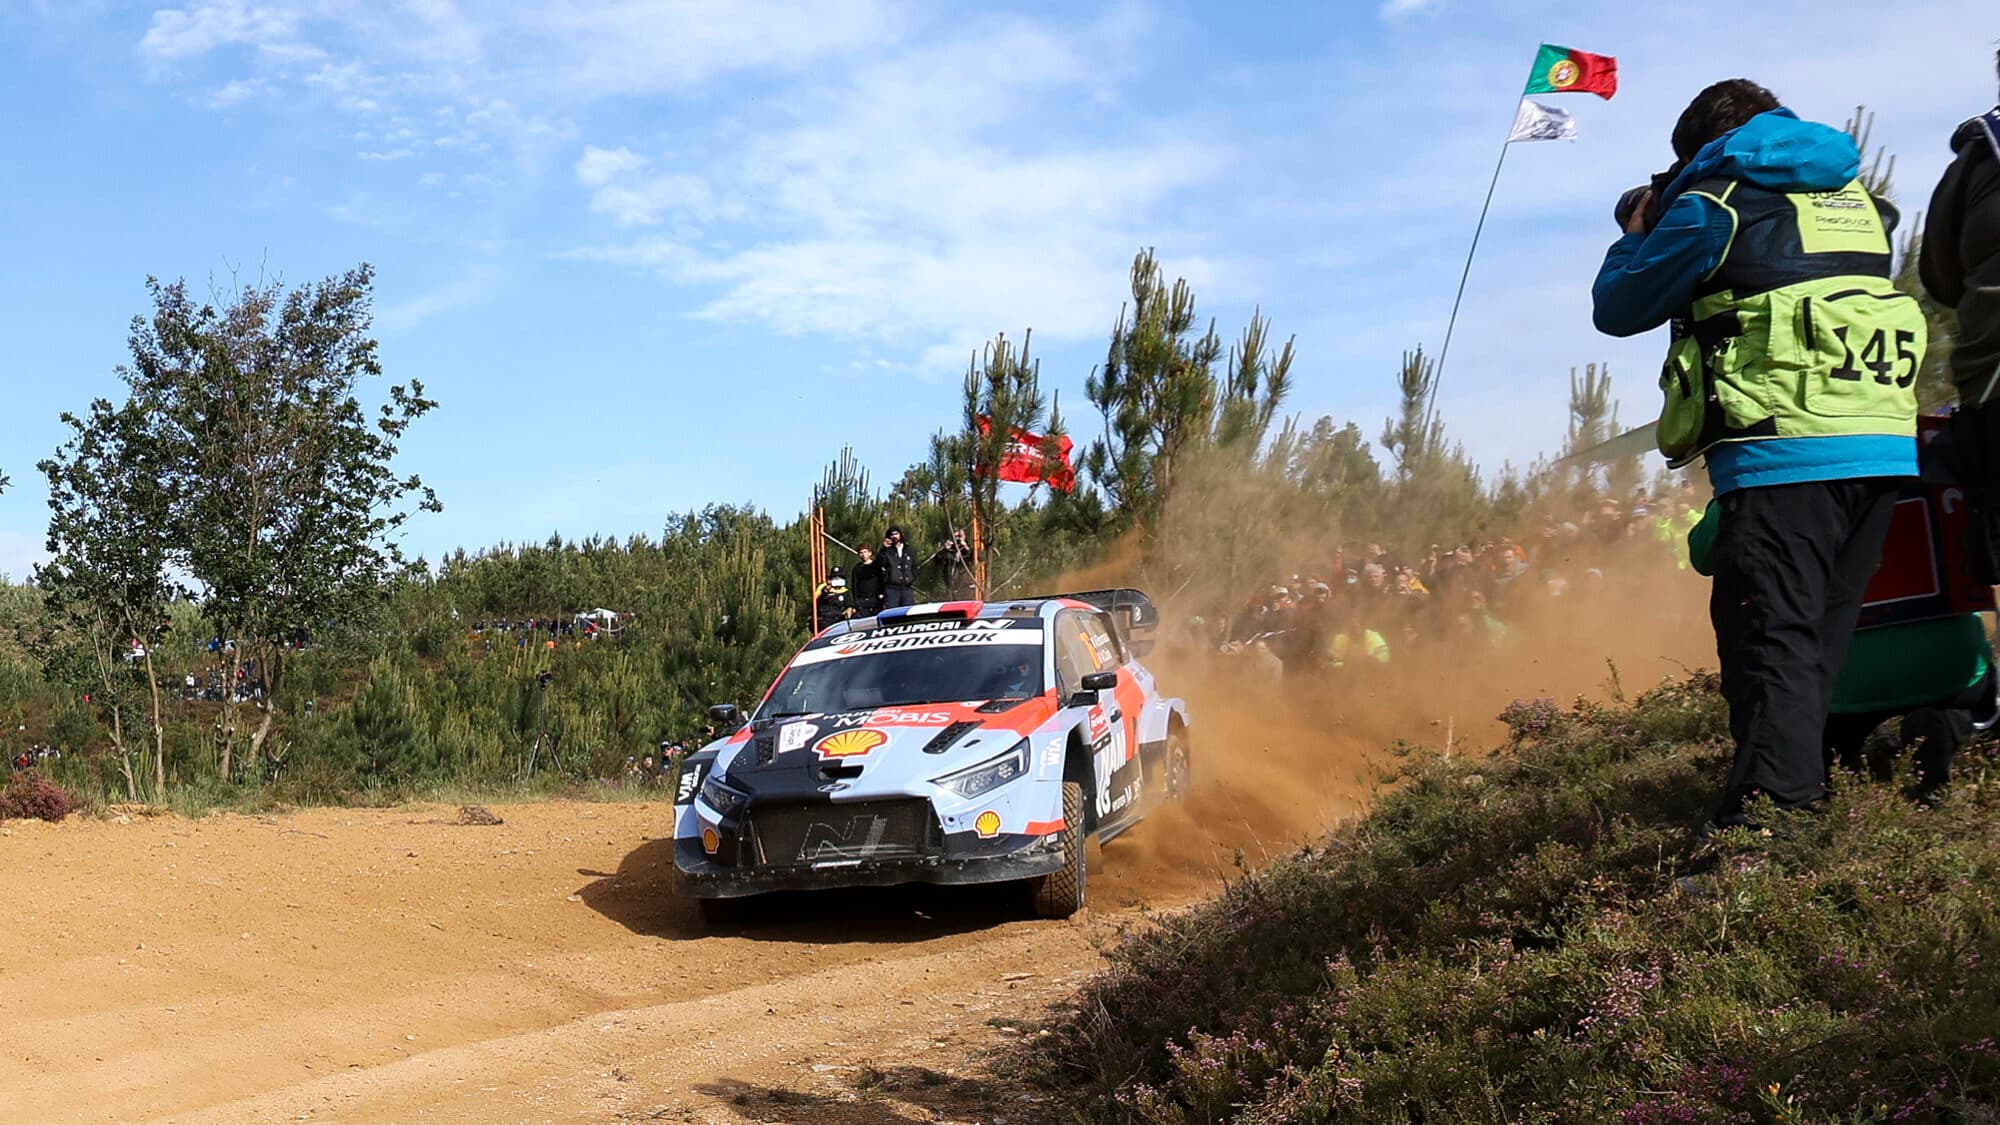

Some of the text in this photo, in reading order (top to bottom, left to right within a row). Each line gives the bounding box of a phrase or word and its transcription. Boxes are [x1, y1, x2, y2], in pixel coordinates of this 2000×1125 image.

[1829, 326, 1917, 388] 145
[870, 621, 961, 638] HYUNDAI
[833, 711, 951, 728] MOBIS
